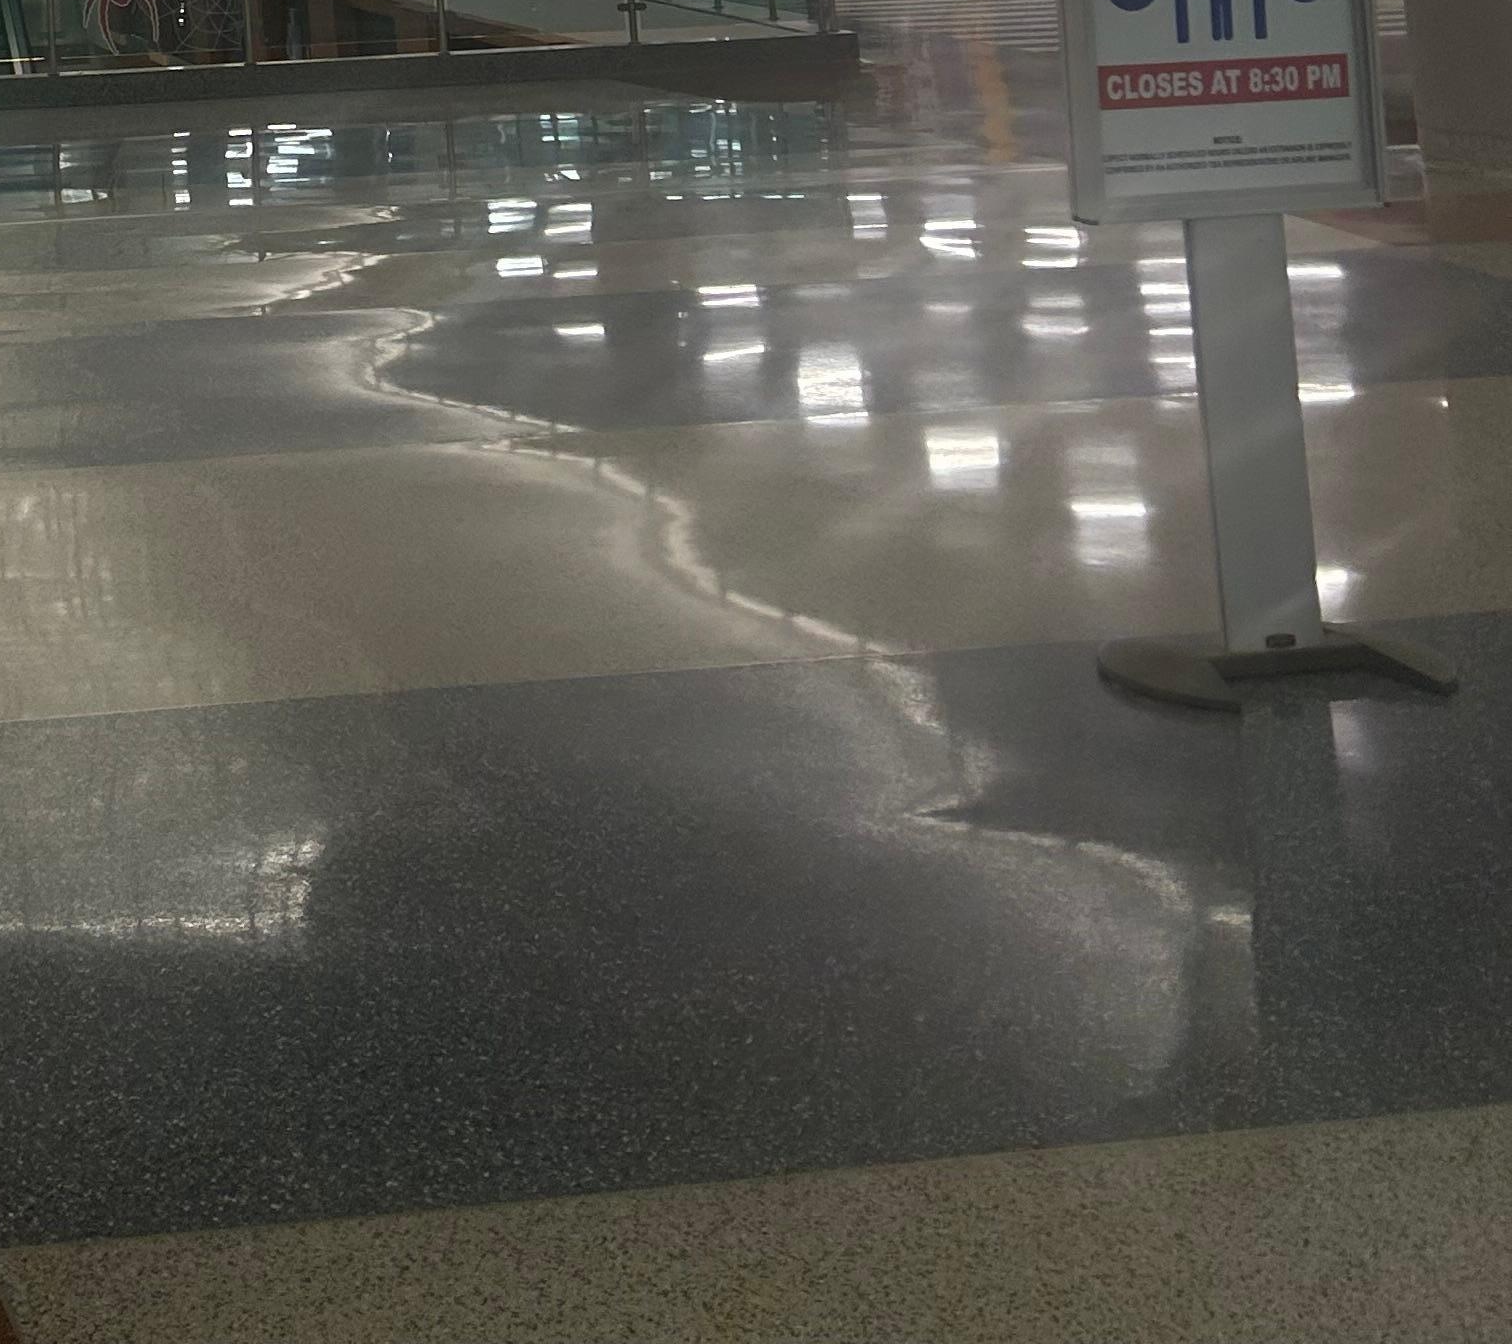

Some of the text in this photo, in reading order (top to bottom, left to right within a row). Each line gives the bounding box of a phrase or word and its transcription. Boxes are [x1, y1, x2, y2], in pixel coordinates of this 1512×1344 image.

[1106, 63, 1342, 101] CLOSES AT 8:30 PM
